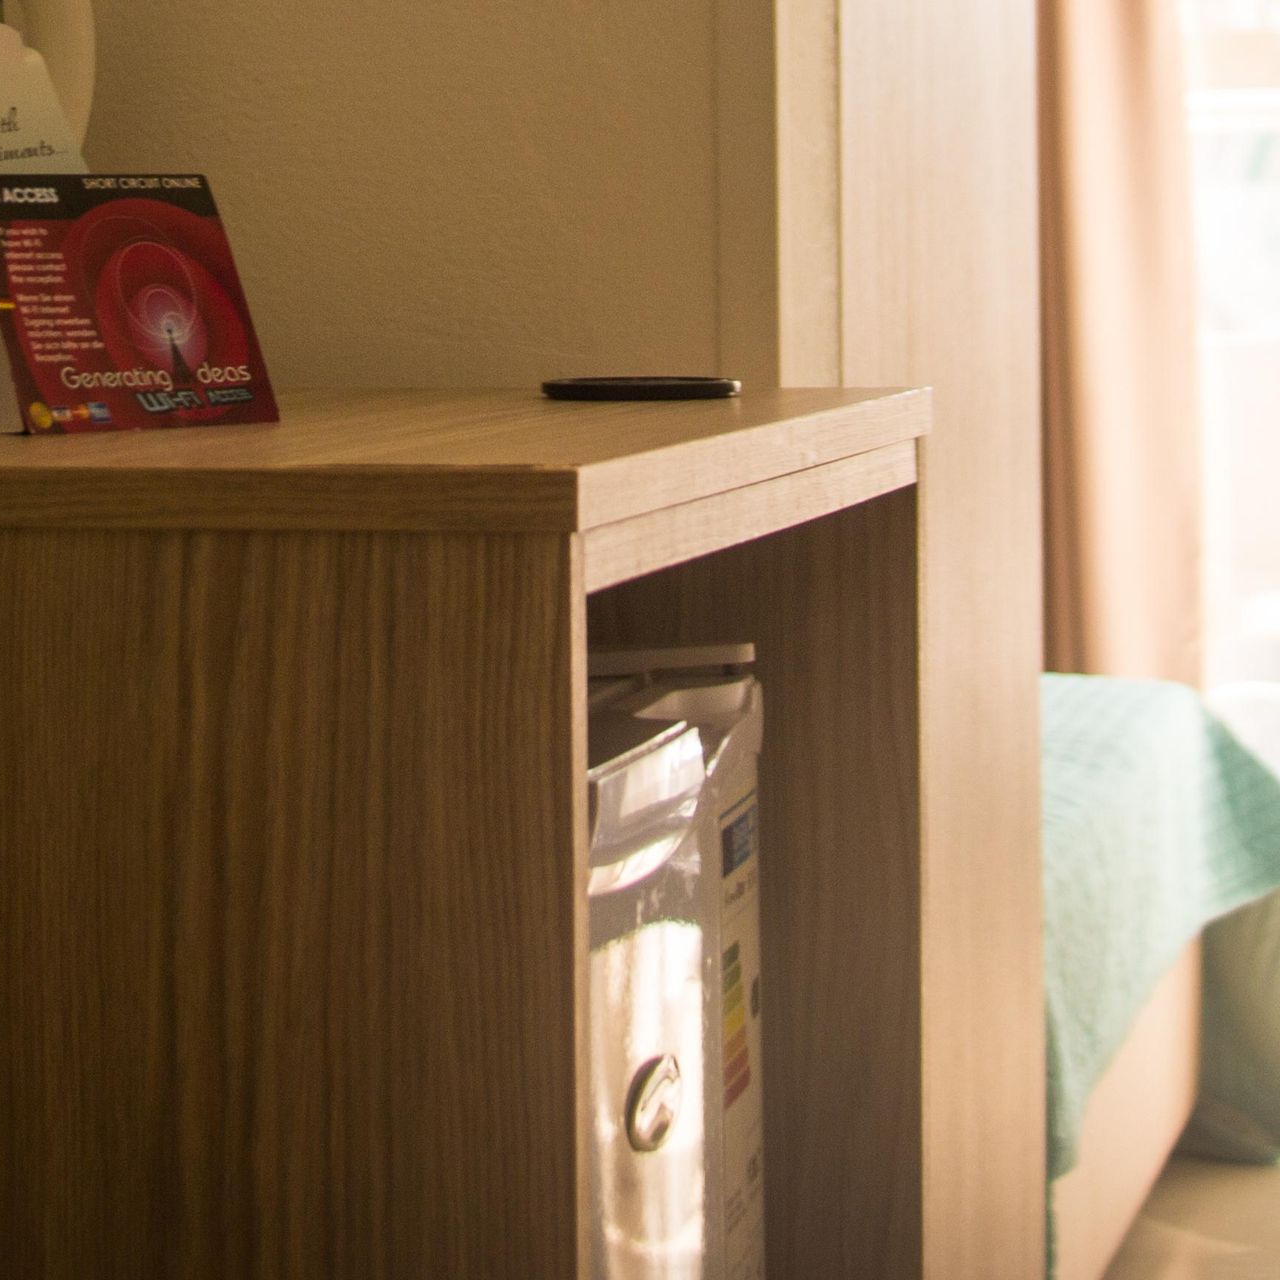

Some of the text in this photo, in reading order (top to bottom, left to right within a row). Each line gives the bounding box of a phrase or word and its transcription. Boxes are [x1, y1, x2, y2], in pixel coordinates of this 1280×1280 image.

[82, 177, 203, 190] SHORT CIRCUIT ONLINE
[3, 187, 60, 204] ACCESS
[61, 366, 175, 392] Generating
